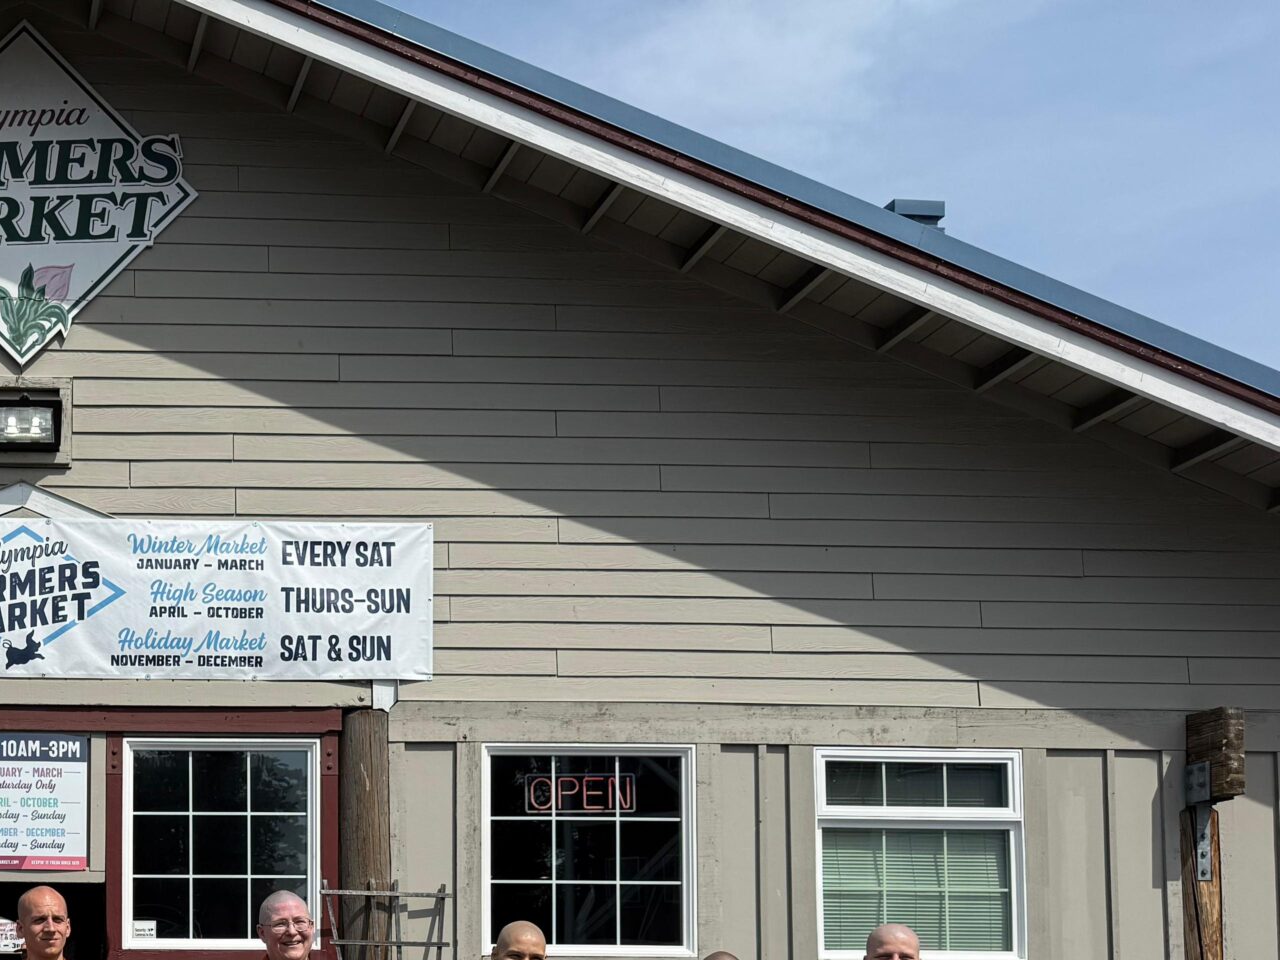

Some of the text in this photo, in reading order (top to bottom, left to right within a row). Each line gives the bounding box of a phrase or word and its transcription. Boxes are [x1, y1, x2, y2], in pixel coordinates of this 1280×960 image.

[127, 533, 268, 556] Winter Market
[281, 541, 396, 568] EVERY SAT
[137, 559, 200, 570] JANUARY
[217, 559, 264, 571] MARCH
[150, 580, 268, 607] High Season
[149, 606, 188, 618] APRIL
[207, 607, 264, 619] OCTOBER
[118, 628, 268, 657] Holiday Market
[280, 635, 392, 662] SAT & SUN
[111, 655, 181, 667] NOVEMBER
[198, 655, 263, 668] DECEMBER
[32, 767, 63, 778] MARCH
[35, 779, 56, 793] Only
[530, 777, 630, 809] OPEN
[20, 797, 59, 808] OCTOBER
[31, 810, 66, 824] Sunday
[26, 828, 66, 837] DECEMBER
[30, 839, 66, 853] Sunday
